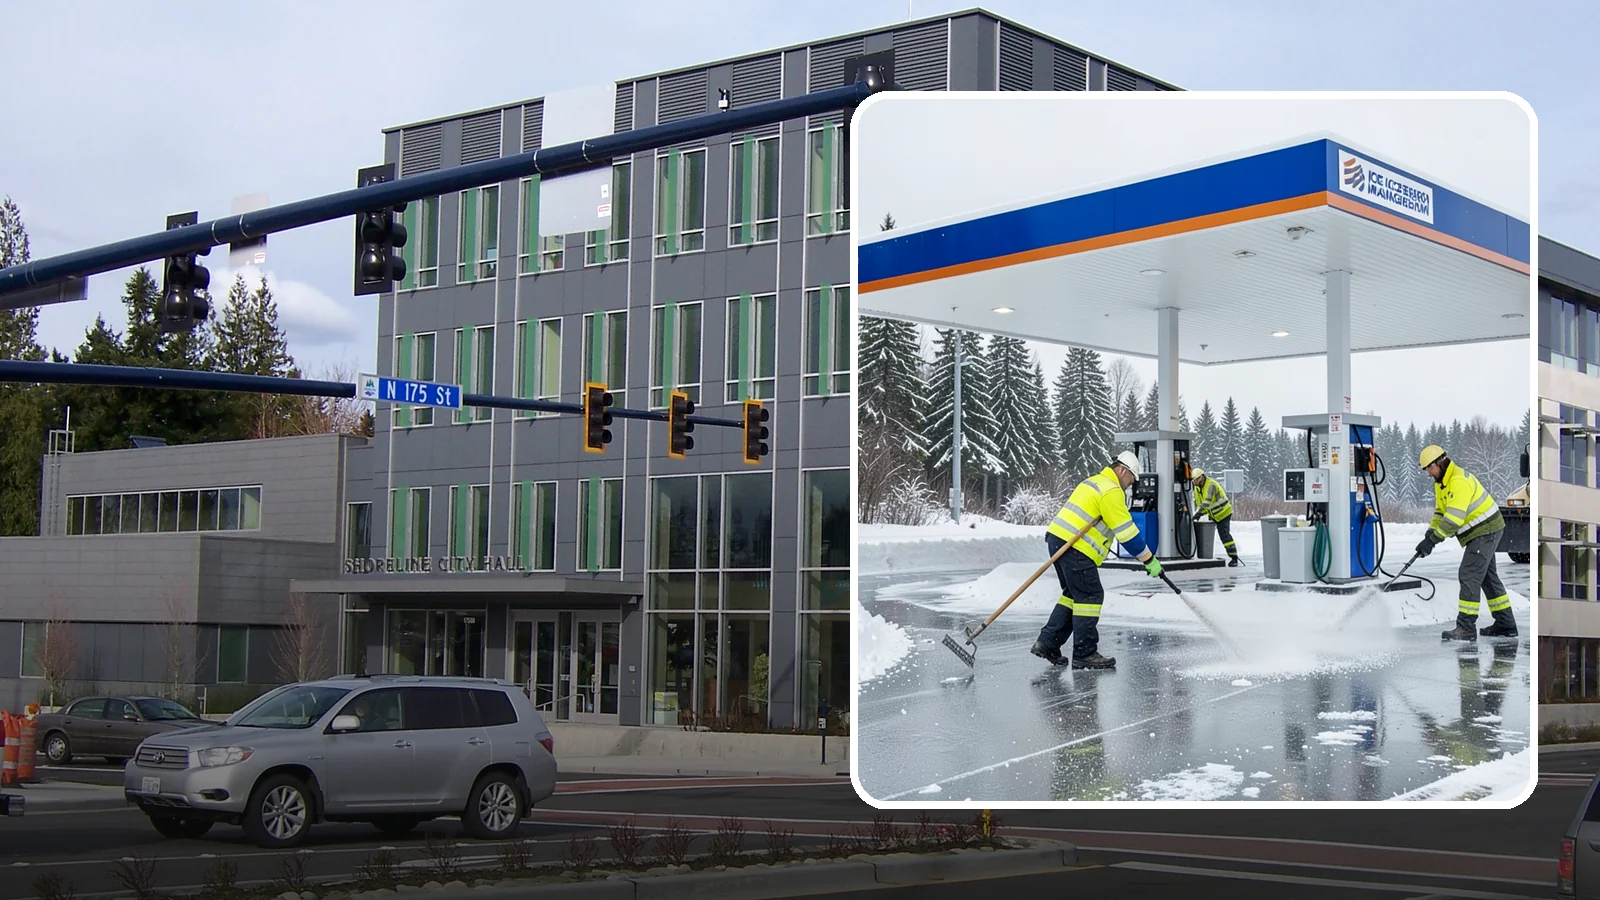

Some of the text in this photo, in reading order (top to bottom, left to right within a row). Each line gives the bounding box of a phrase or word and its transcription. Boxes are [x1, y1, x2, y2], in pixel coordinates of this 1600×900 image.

[387, 381, 451, 406] N 175 St
[344, 555, 526, 574] SHORELINE CITY HALL
